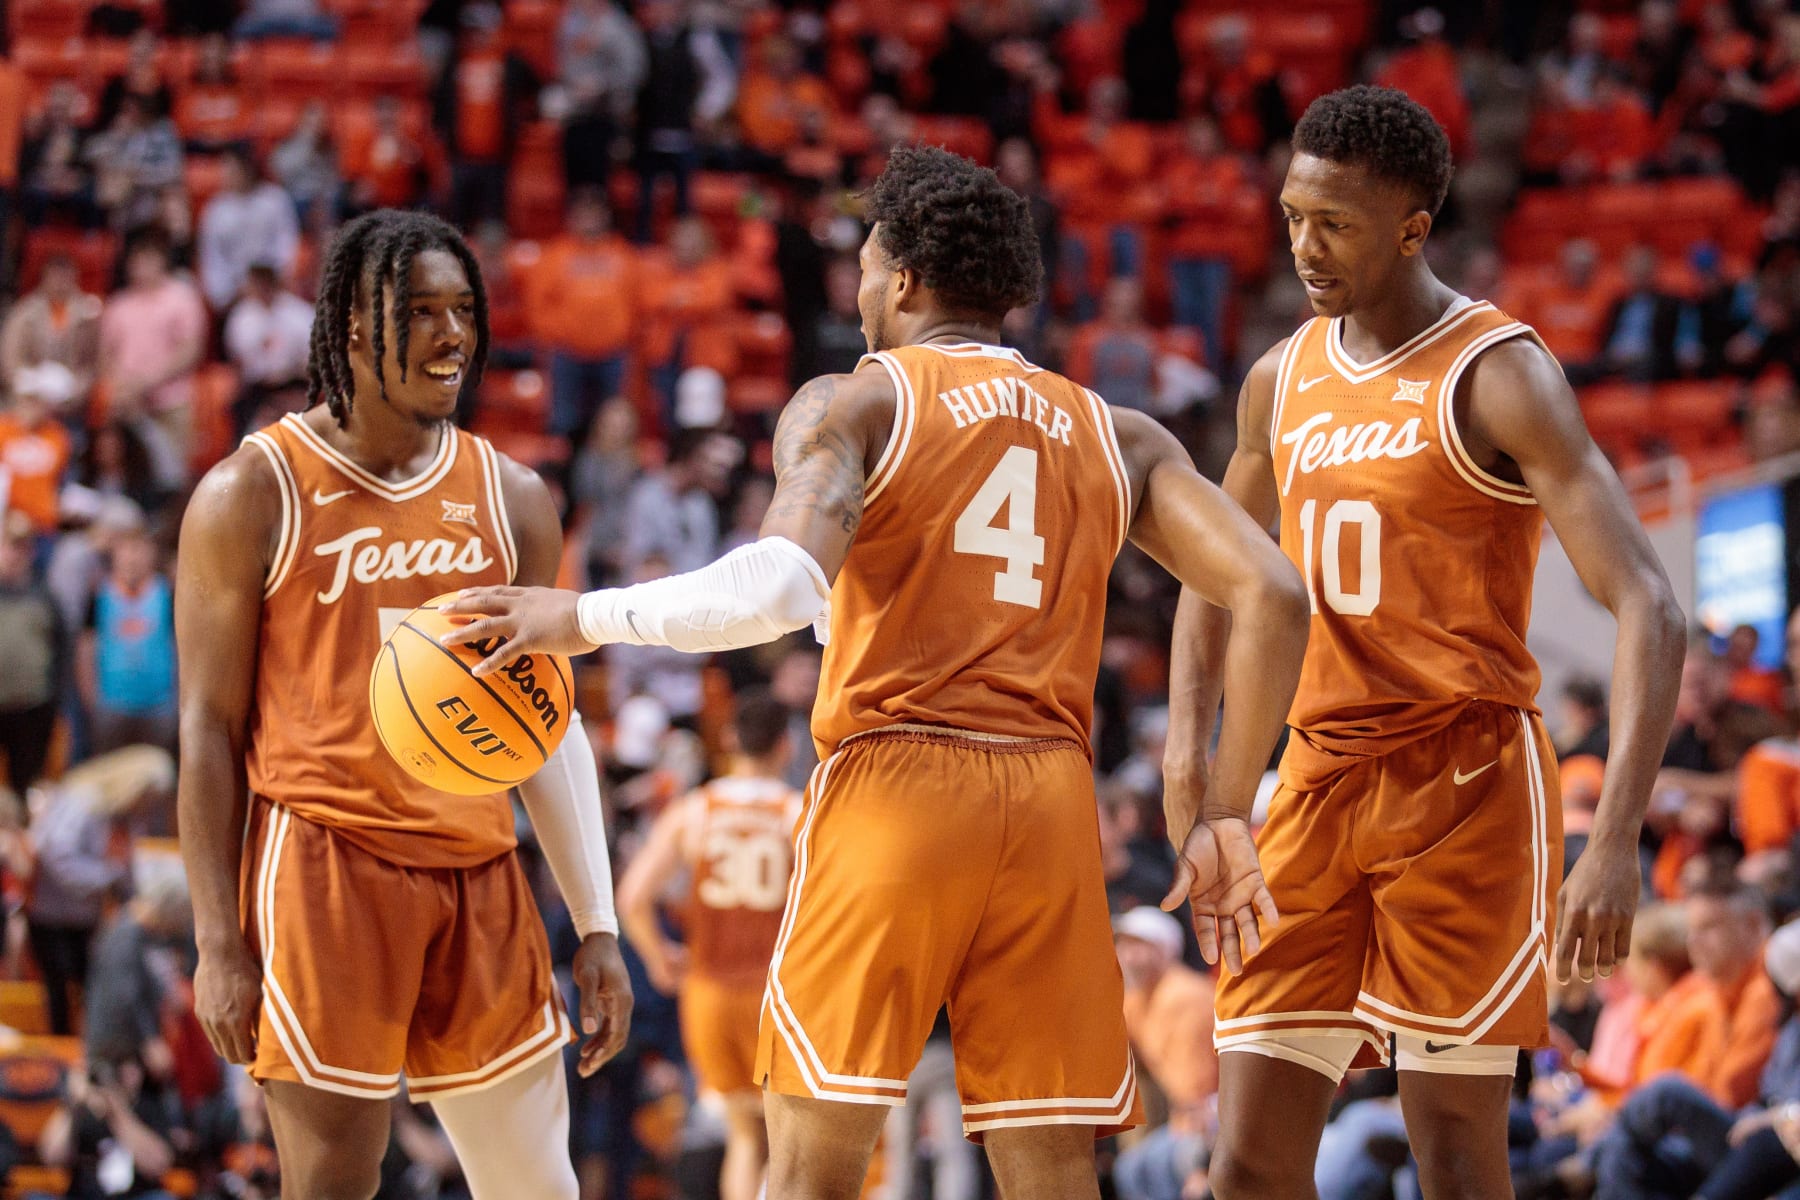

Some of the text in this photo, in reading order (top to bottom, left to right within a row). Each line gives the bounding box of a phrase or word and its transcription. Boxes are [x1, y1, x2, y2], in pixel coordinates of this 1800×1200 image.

[938, 377, 1073, 446] HUNTER
[1282, 412, 1430, 497] Texas
[314, 526, 494, 605] Texas
[953, 445, 1045, 609] 4
[1300, 499, 1382, 616] 10
[464, 619, 559, 732] lson
[436, 696, 523, 761] EVO NXT
[700, 833, 788, 911] 30
